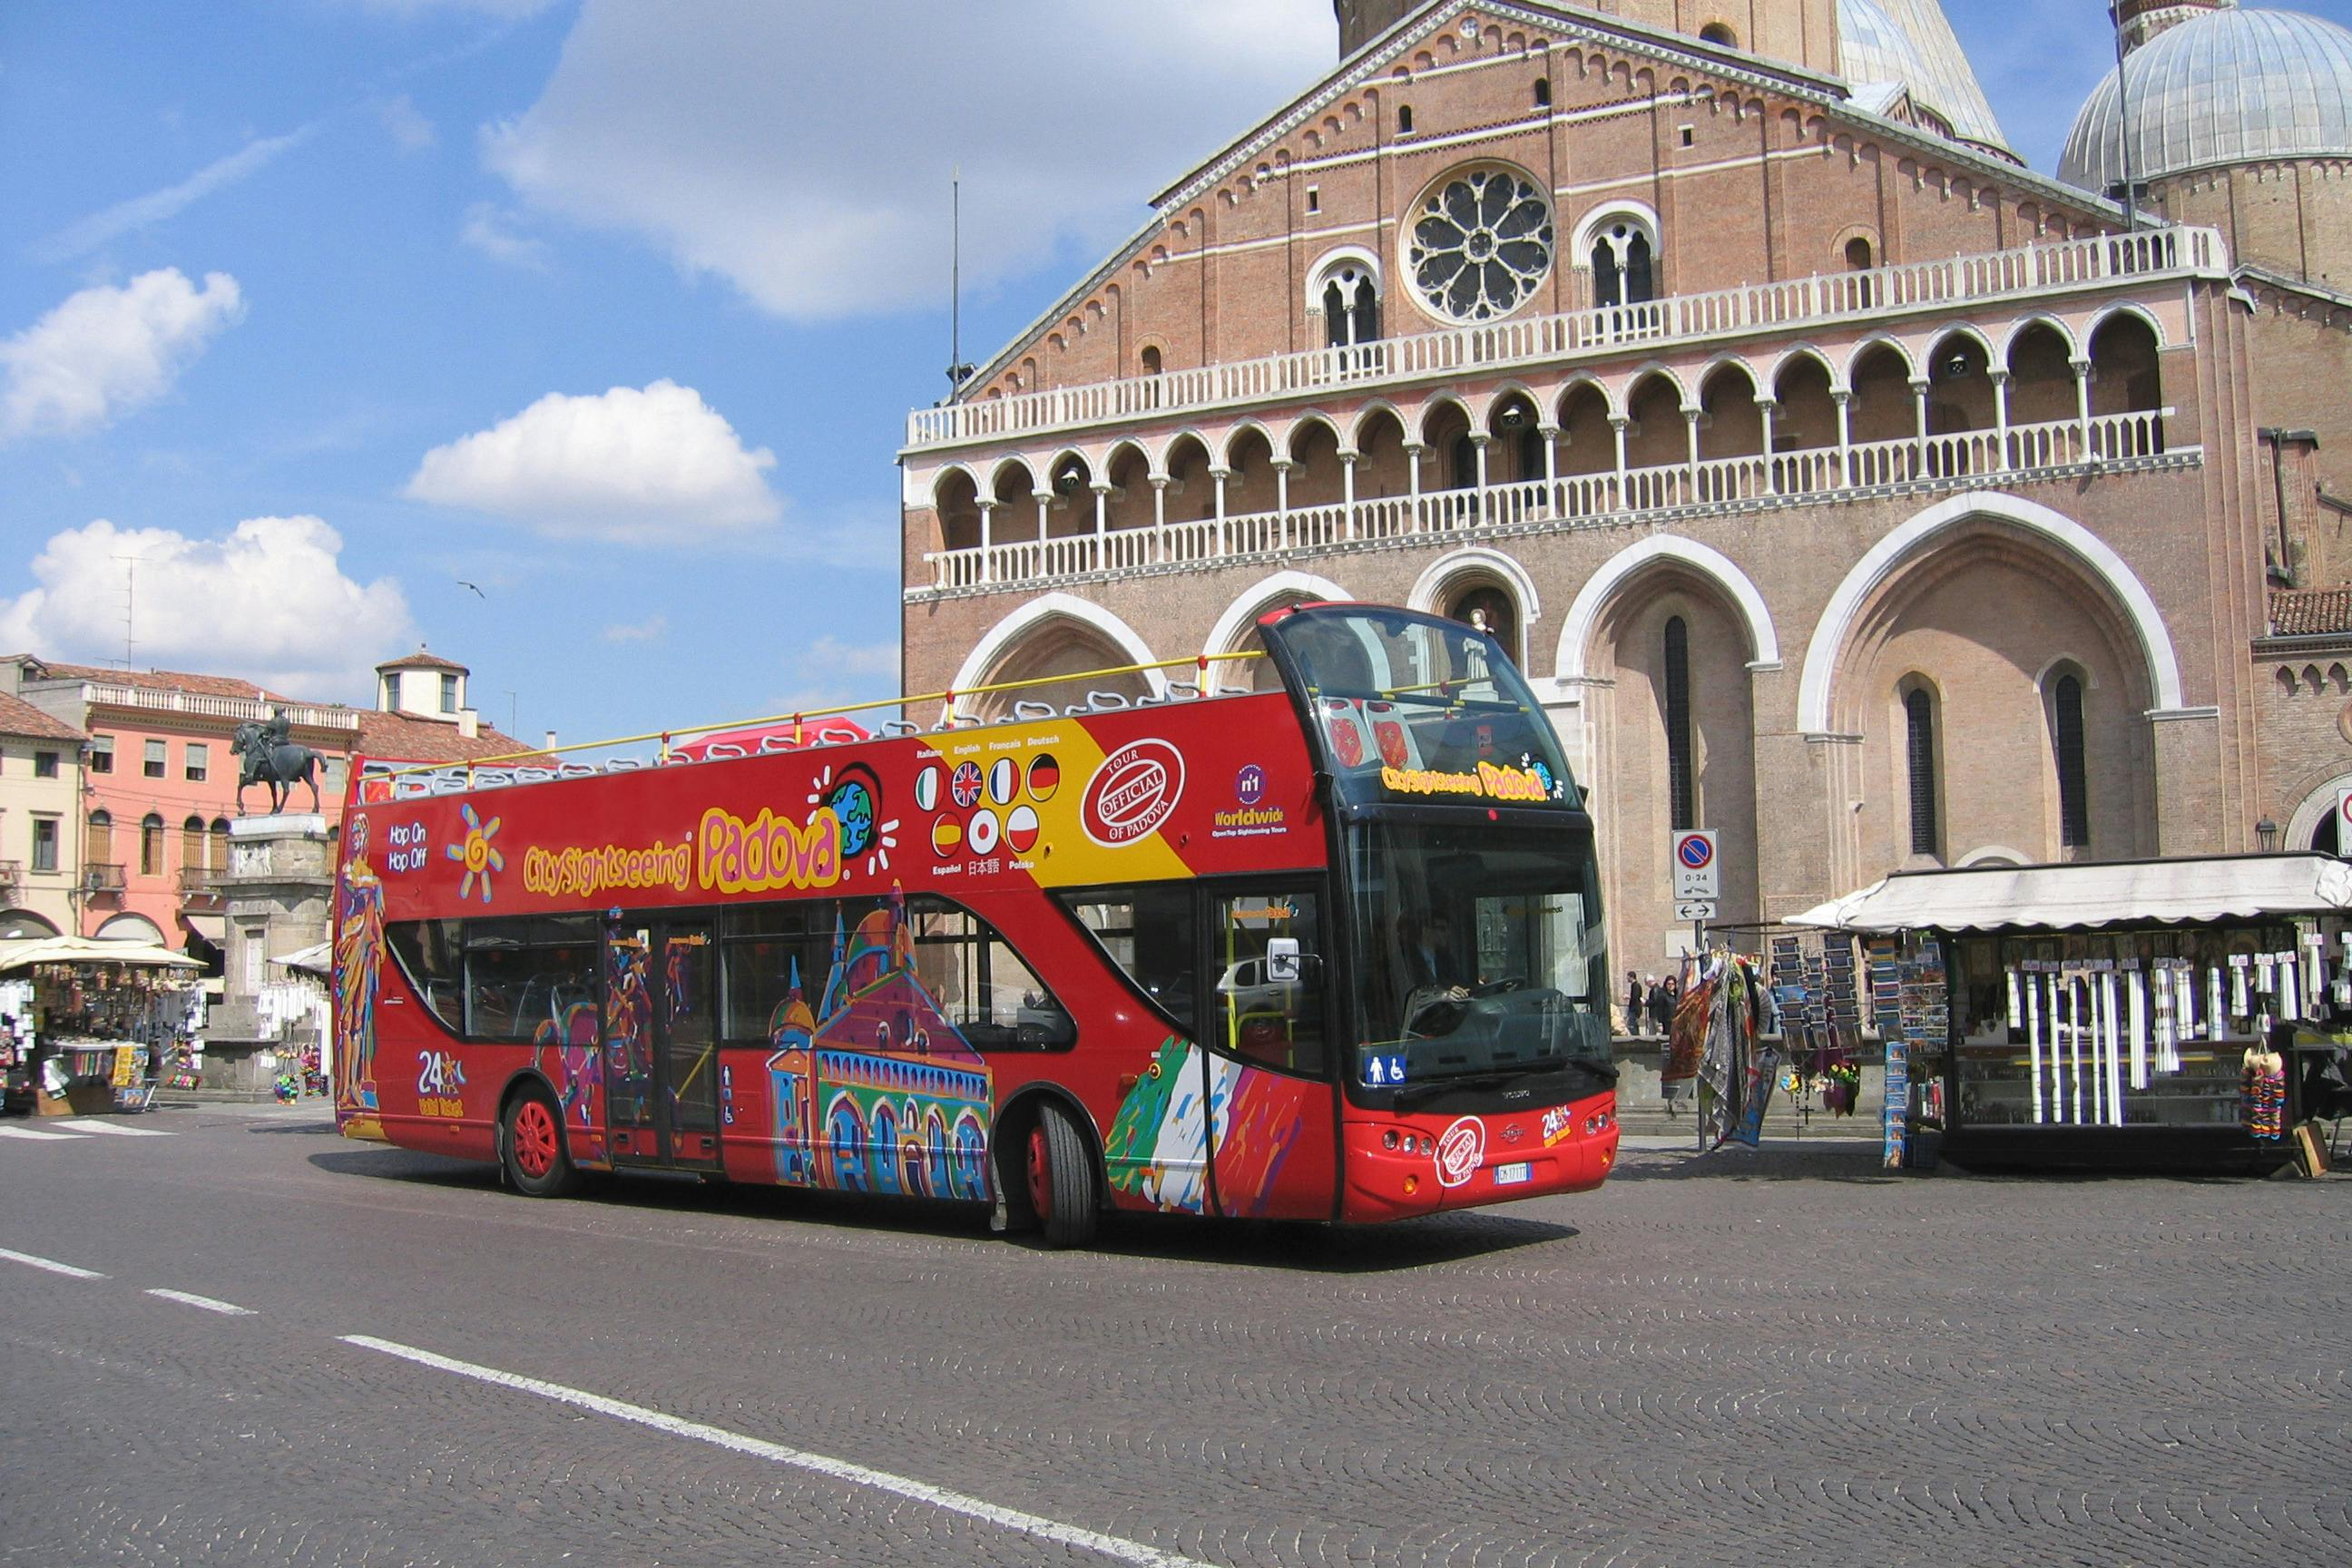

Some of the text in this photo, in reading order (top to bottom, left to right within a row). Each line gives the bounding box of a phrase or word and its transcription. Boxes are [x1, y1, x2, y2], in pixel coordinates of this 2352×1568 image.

[954, 744, 981, 755] English
[1027, 735, 1060, 747] Deutsch
[916, 750, 943, 759] Italiano
[1106, 750, 1139, 774] TOUR
[1102, 770, 1162, 816] OFFICIAL
[1382, 760, 1546, 801] CitySightseeing Padova
[1109, 799, 1170, 840] OF PADOVA
[1214, 808, 1284, 827] Worldwide
[389, 821, 426, 847] Hop On
[388, 847, 427, 873] Hop Off
[524, 806, 841, 897] CitySightseeing Padova
[968, 858, 1000, 876] 日本語
[418, 1051, 444, 1093] 24
[1542, 1109, 1558, 1138] 24
